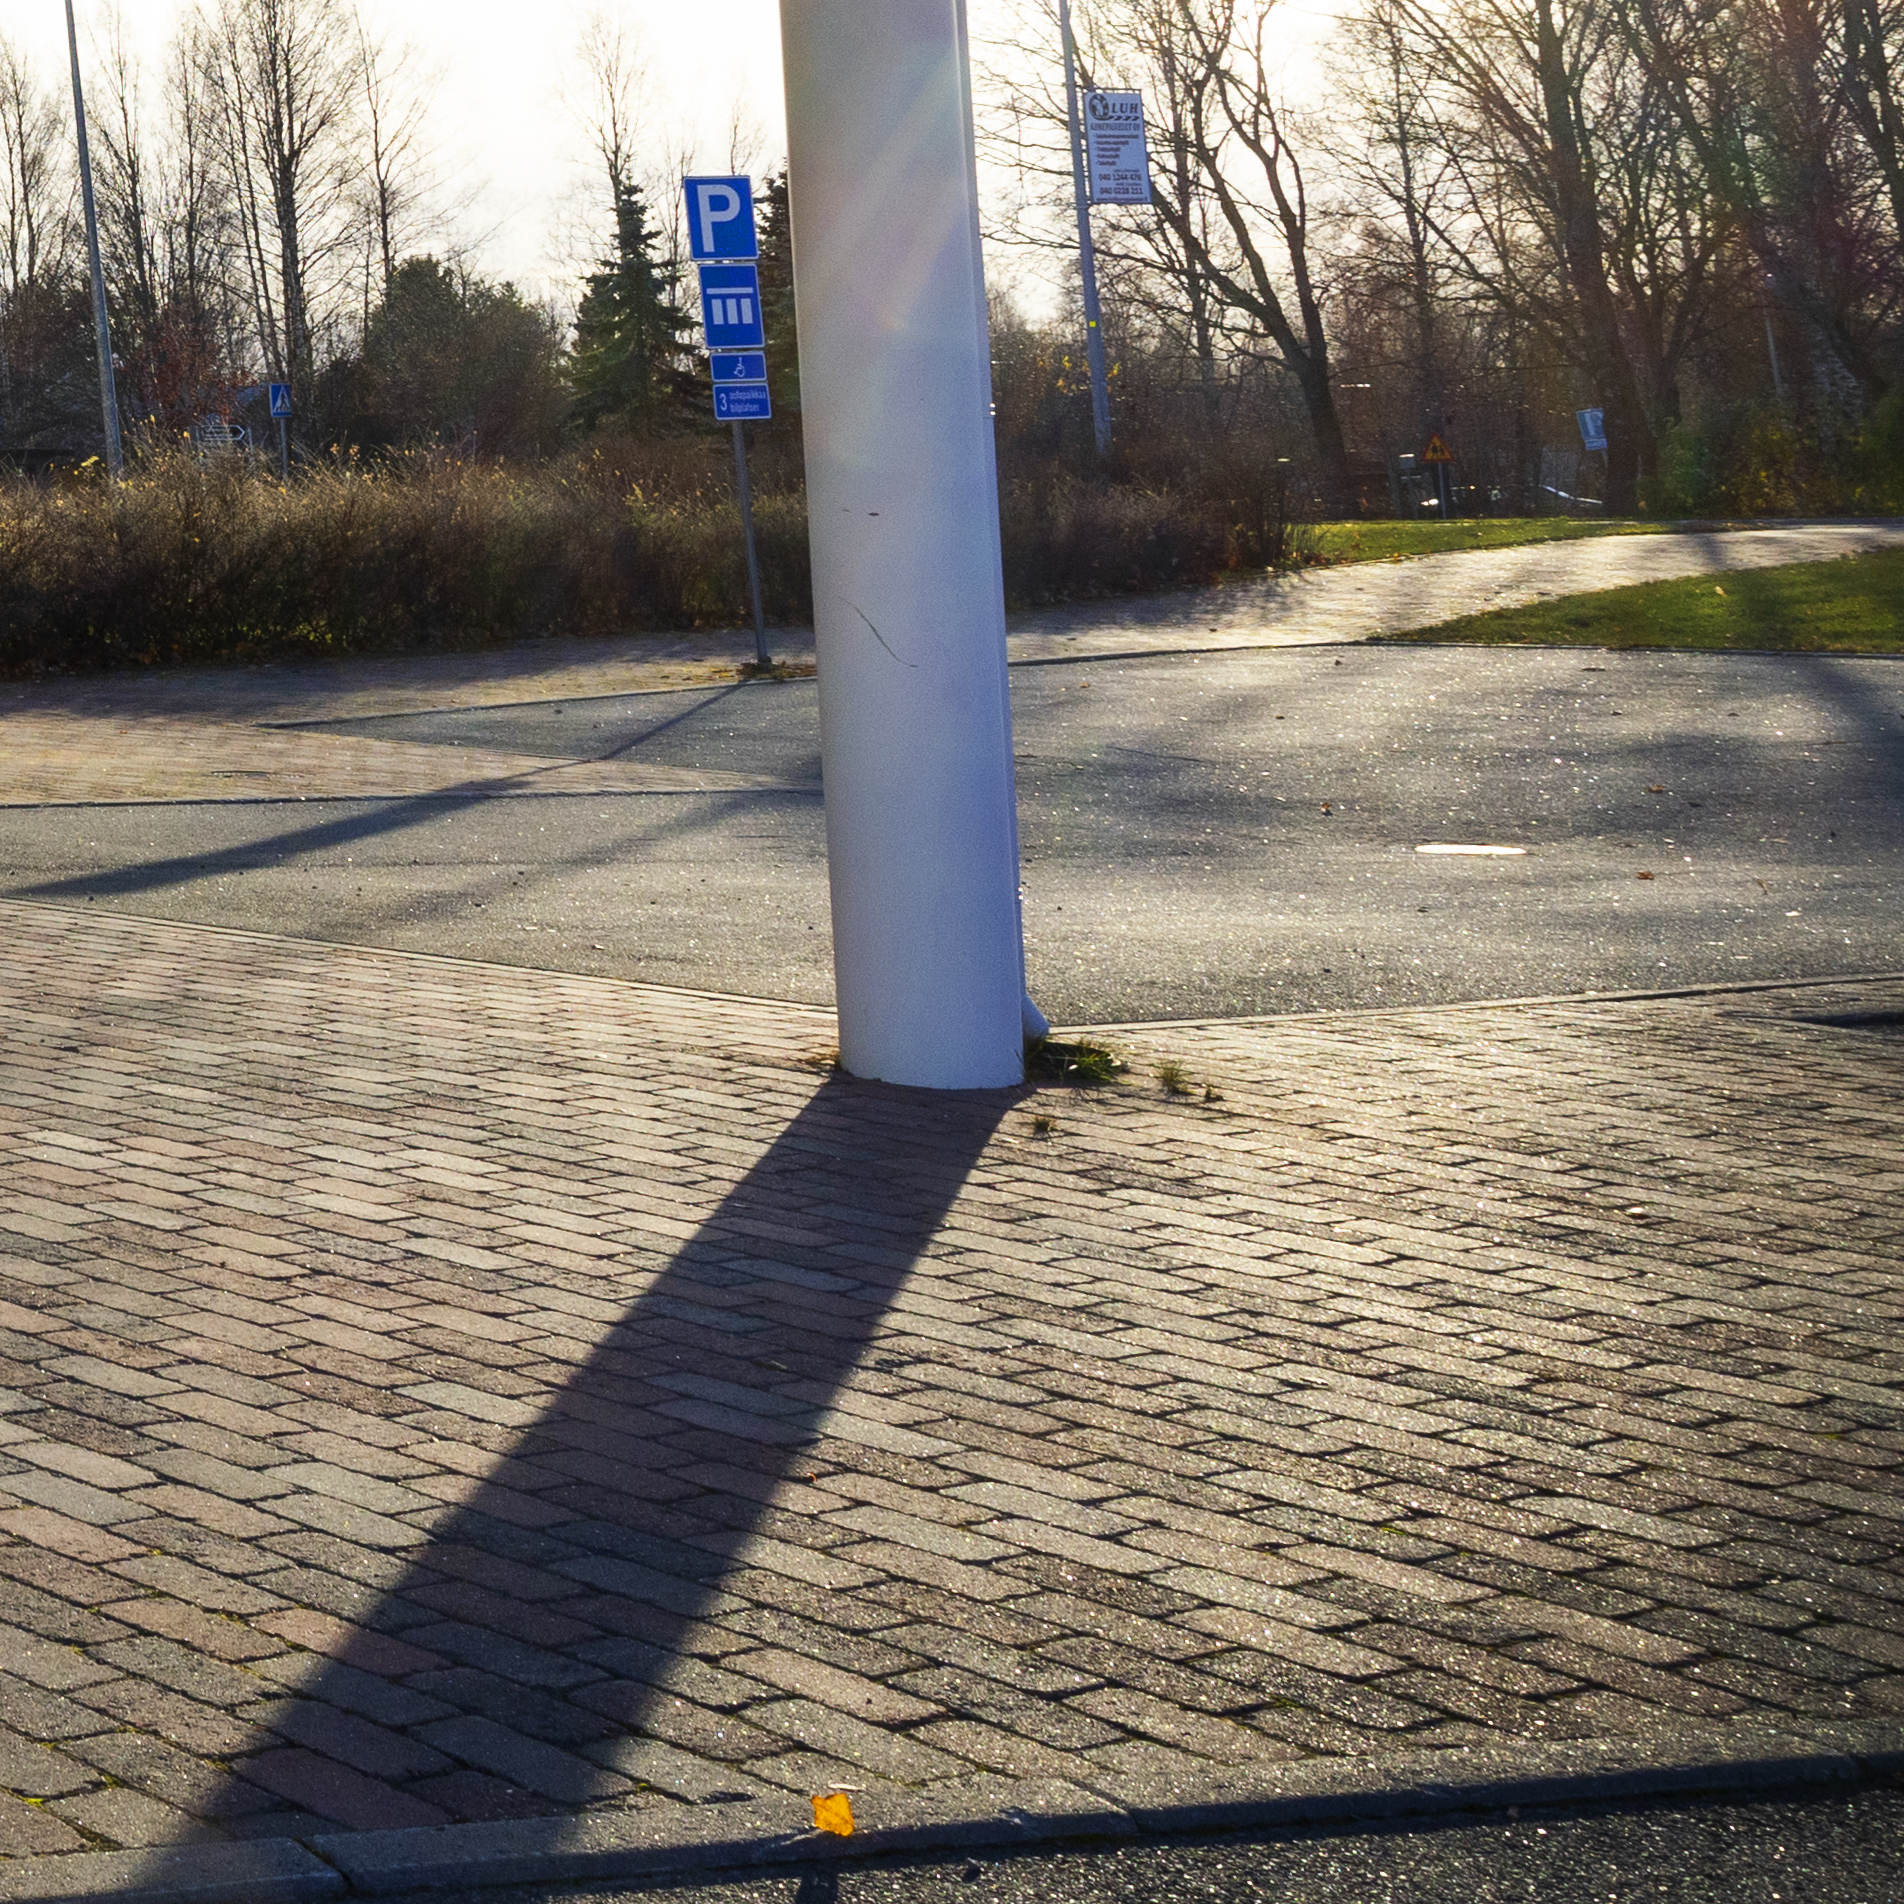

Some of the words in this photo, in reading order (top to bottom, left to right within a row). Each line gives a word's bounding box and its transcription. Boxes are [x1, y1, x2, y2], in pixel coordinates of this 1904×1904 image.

[1112, 103, 1139, 114] LUH
[697, 183, 741, 253] P
[719, 392, 728, 411] 3
